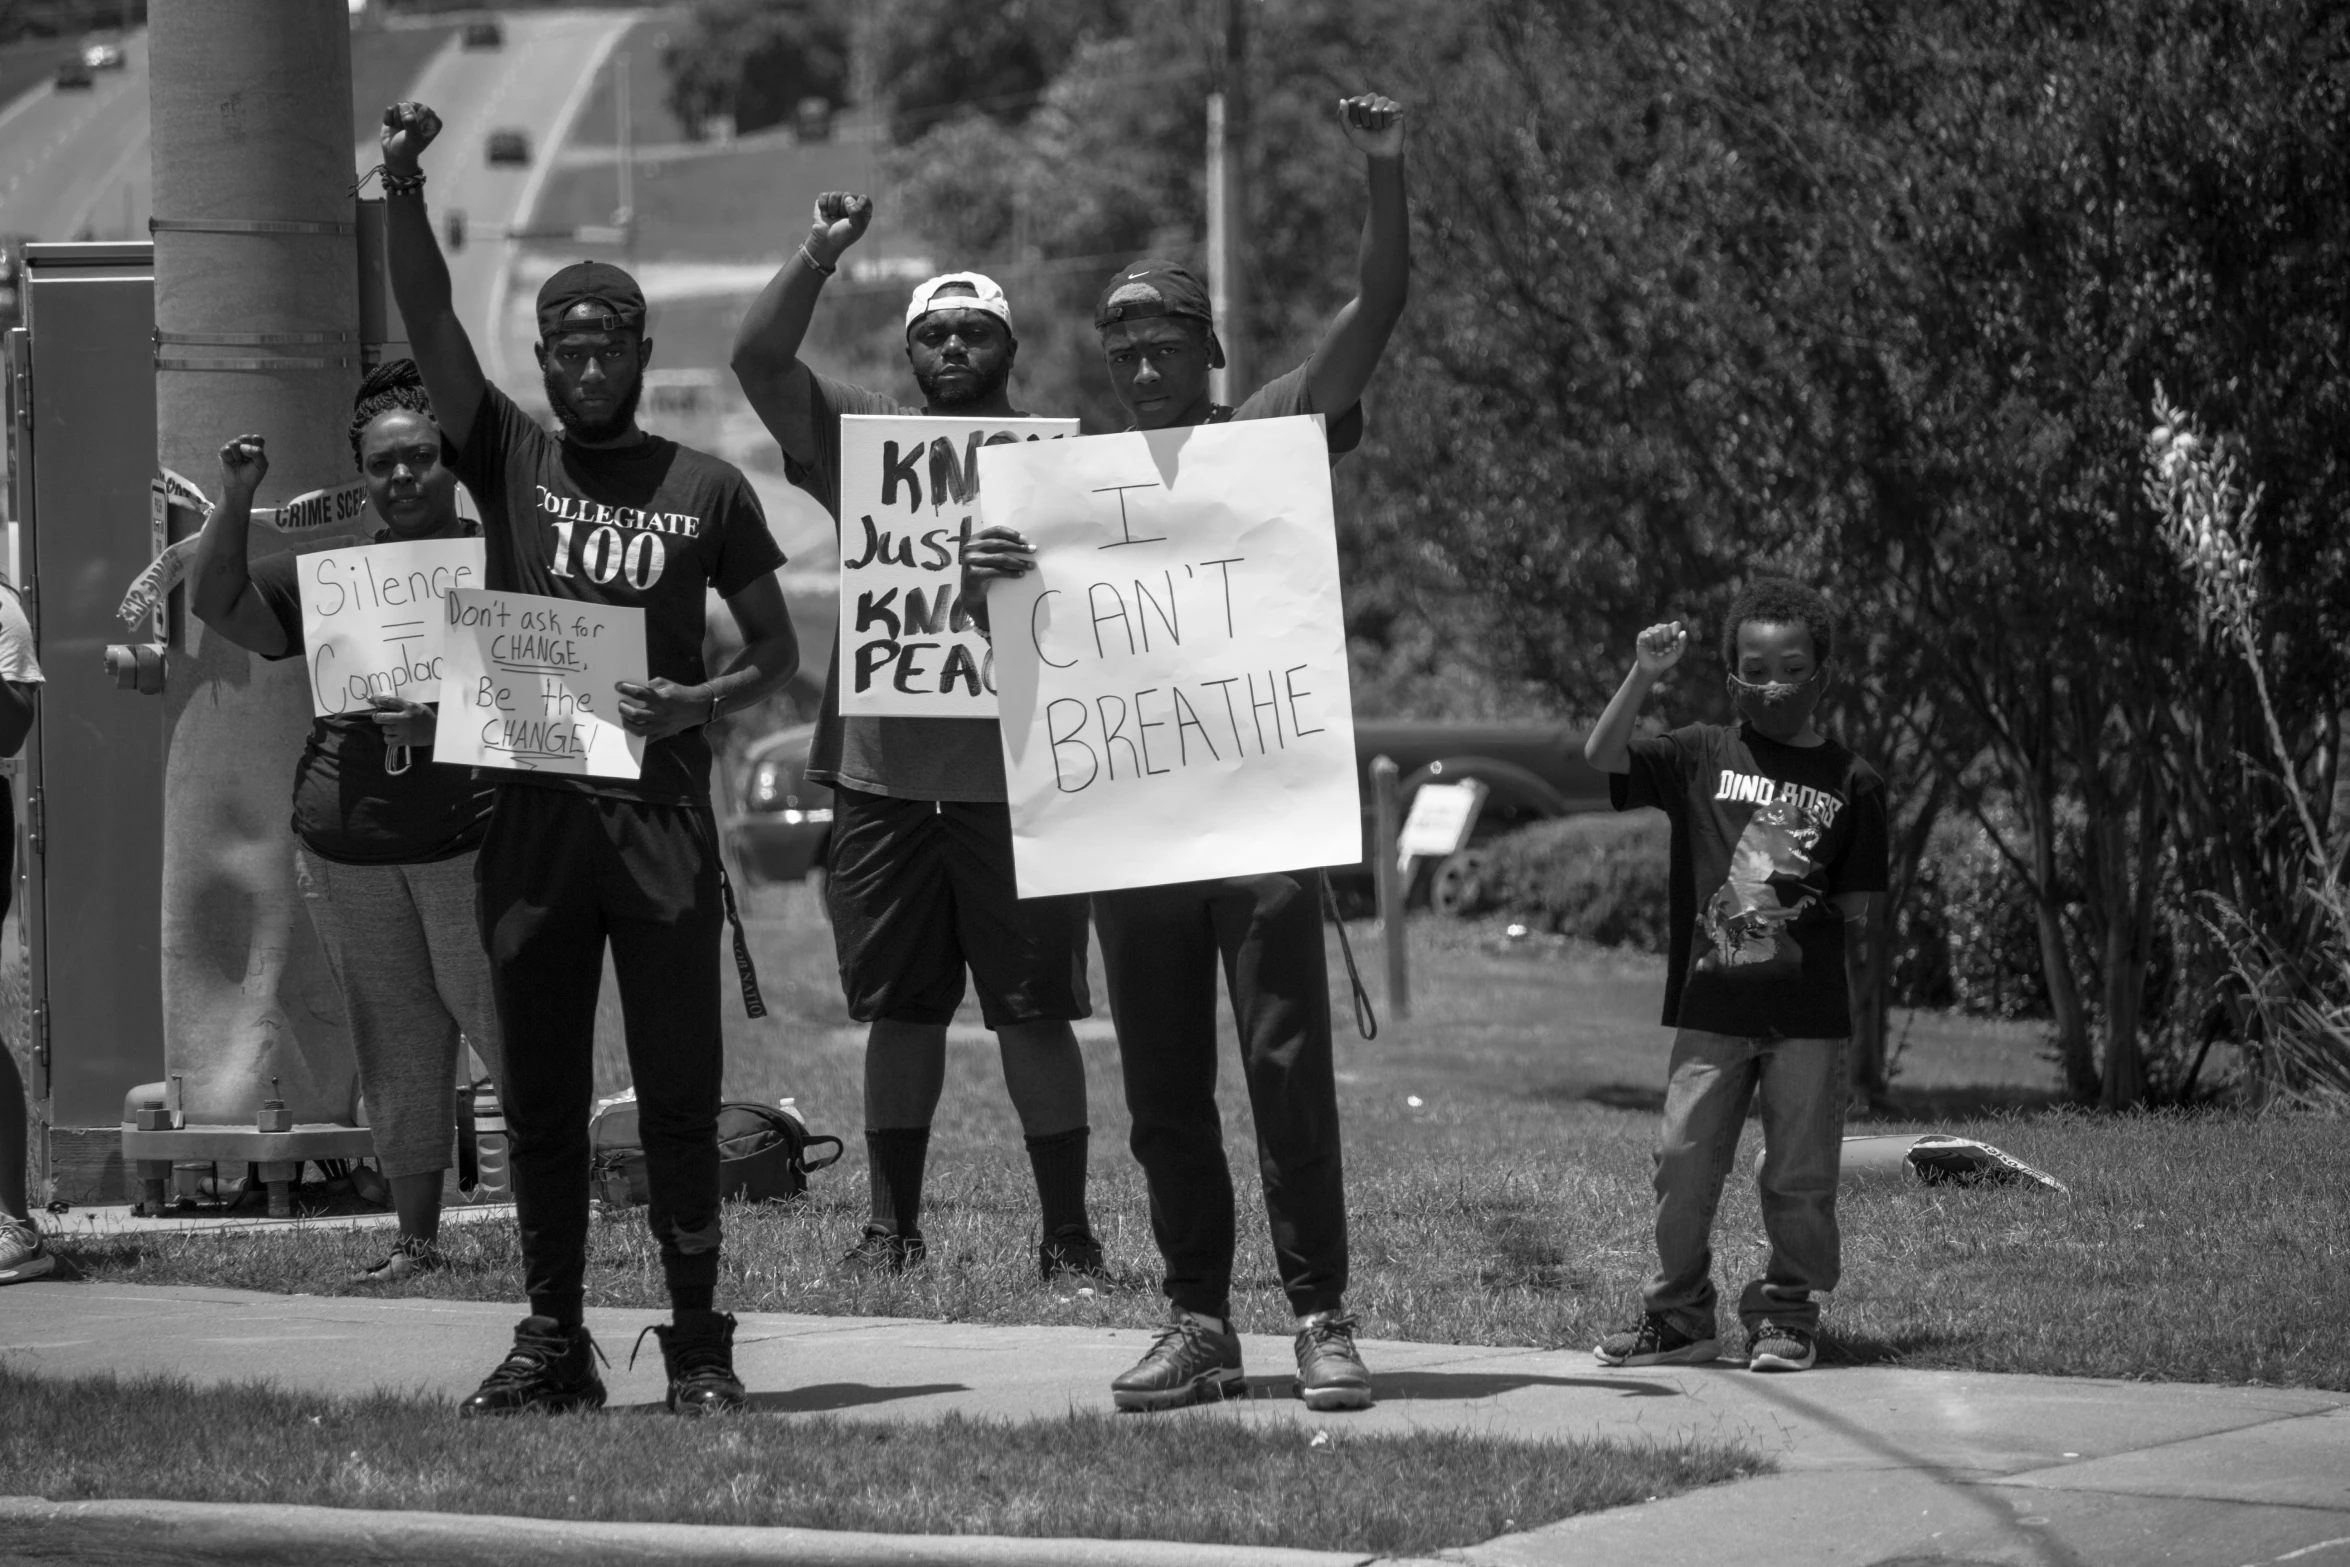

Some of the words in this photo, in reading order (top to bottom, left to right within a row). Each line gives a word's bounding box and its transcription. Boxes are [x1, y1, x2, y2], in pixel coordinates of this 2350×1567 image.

[275, 495, 332, 528] CRIME
[536, 484, 700, 539] COLLEGIATE
[1091, 483, 1168, 550] I
[547, 520, 666, 591] 100
[316, 556, 473, 617] Silence
[449, 590, 511, 628] Don't
[520, 609, 562, 635] ask
[571, 616, 605, 638] for
[1031, 558, 1245, 668] CAN'T
[476, 675, 516, 711] Be
[541, 678, 595, 716] the
[481, 718, 599, 761] CHANGE!
[1047, 664, 1326, 793] BREATHE
[1714, 769, 1775, 807] DINO
[1782, 780, 1844, 829] BOSS
[740, 971, 764, 1018] NATIO
